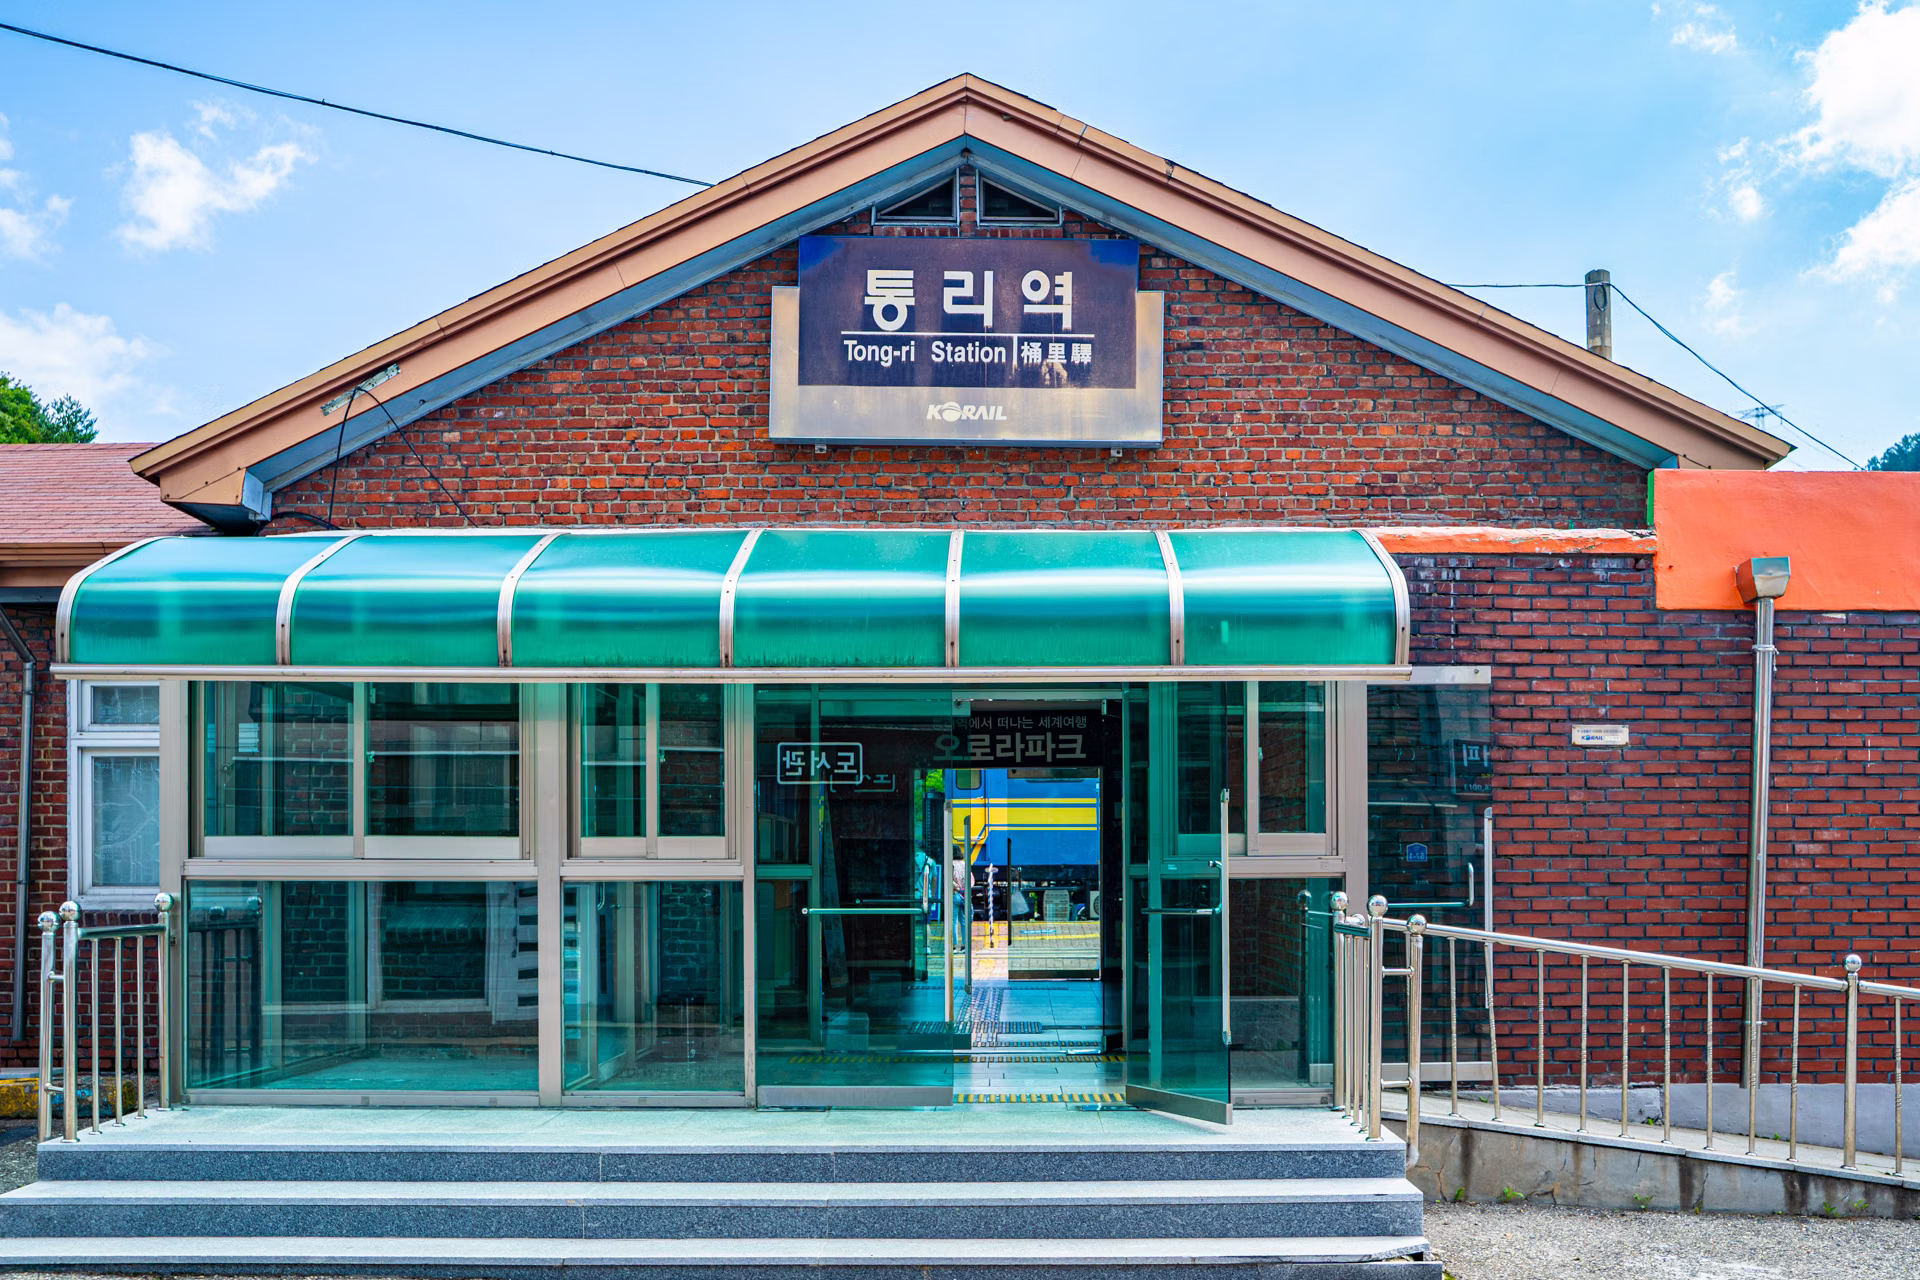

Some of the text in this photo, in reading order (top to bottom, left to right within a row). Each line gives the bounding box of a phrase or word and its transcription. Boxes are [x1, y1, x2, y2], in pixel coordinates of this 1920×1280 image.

[864, 269, 1073, 331] 통리역
[843, 340, 1006, 367] Tong-ri Station
[1020, 341, 1092, 365] 桶里驛
[926, 401, 1008, 422] KORAIL
[997, 716, 1034, 729] 떠나는
[1038, 715, 1088, 729] 세계여행
[933, 732, 1087, 763] 오로라파크
